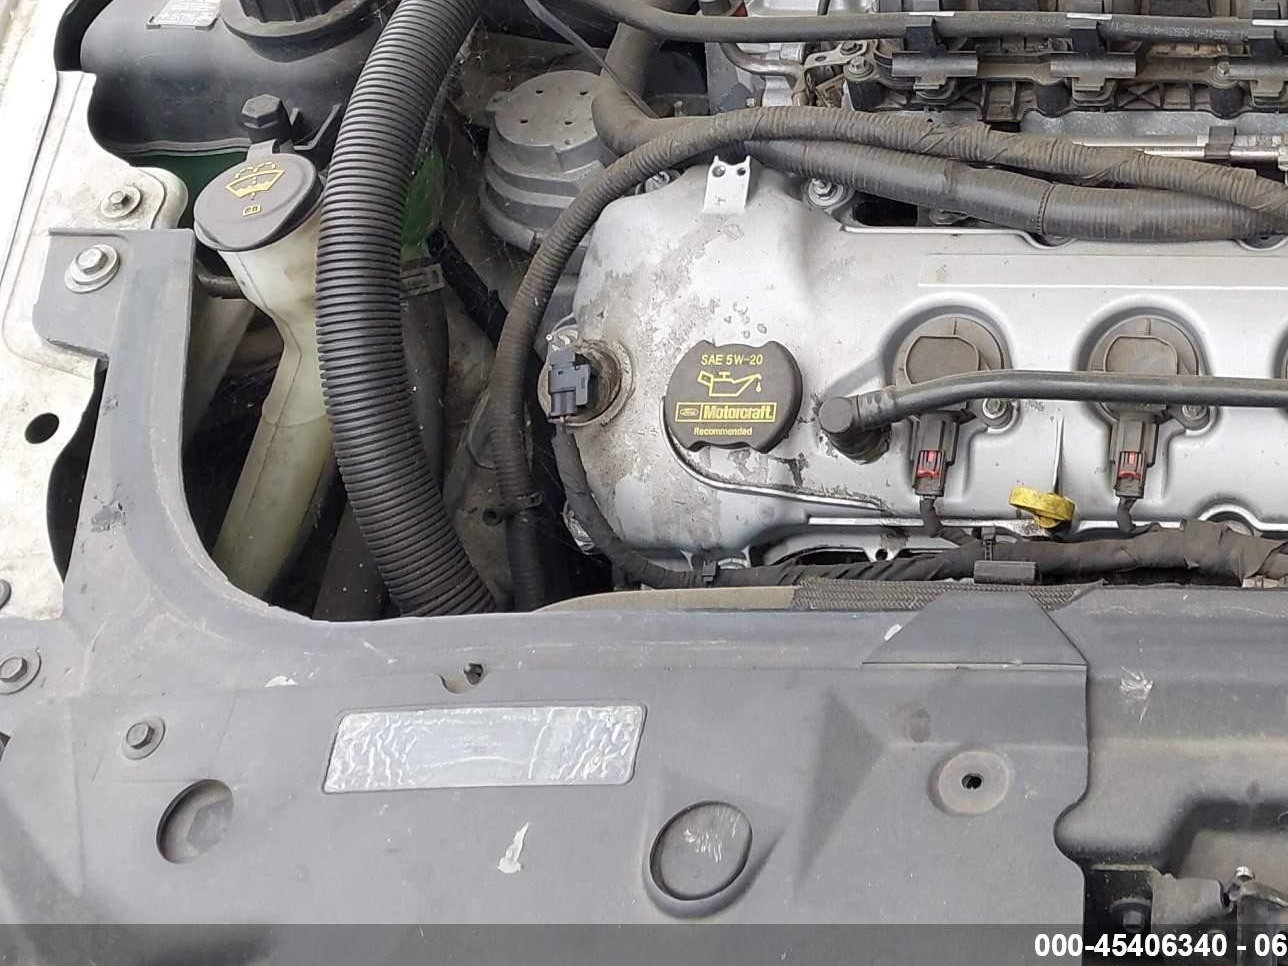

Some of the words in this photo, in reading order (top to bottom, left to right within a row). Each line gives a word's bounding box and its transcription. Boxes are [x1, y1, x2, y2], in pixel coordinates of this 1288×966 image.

[701, 354, 722, 365] SAE
[726, 354, 763, 365] 5W-20
[694, 427, 753, 435] Recommended
